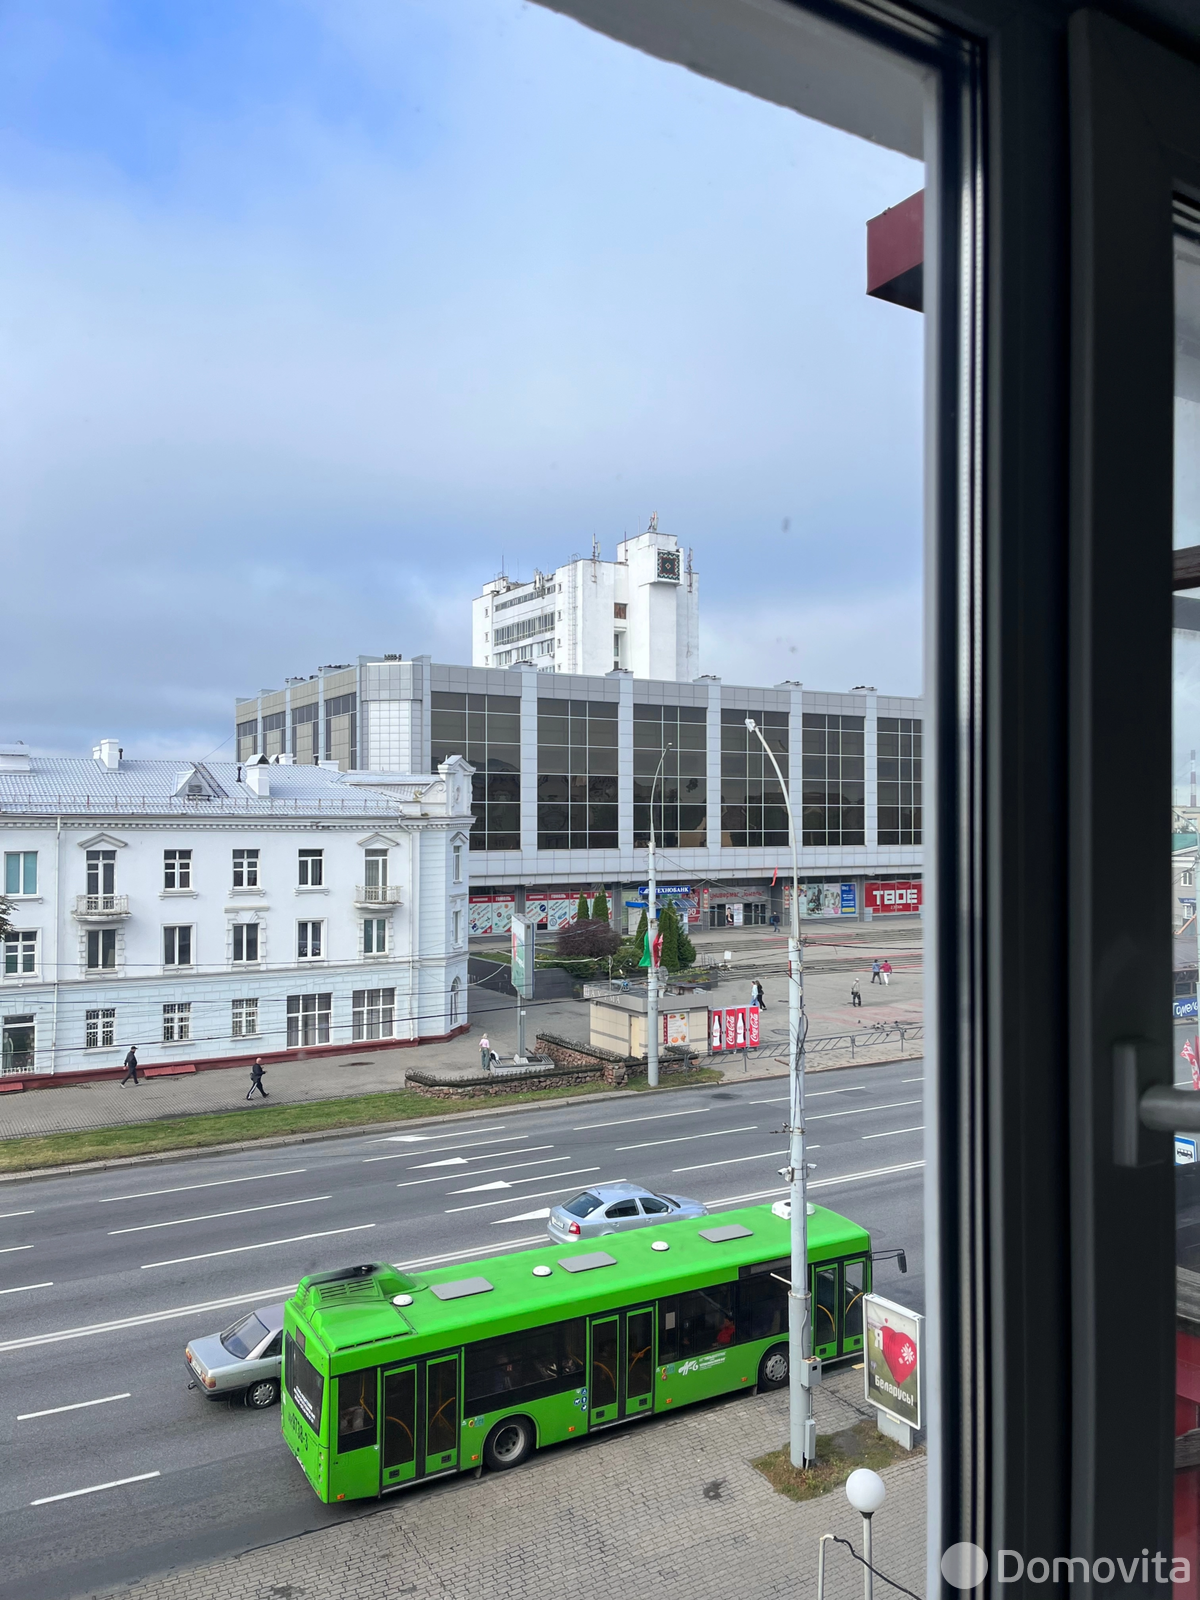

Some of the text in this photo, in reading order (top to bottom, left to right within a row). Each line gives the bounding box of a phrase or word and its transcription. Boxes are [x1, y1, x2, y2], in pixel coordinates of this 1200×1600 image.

[872, 889, 918, 905] ТВОЕ
[874, 1329, 884, 1351] Я
[874, 1374, 914, 1406] Беларусь!
